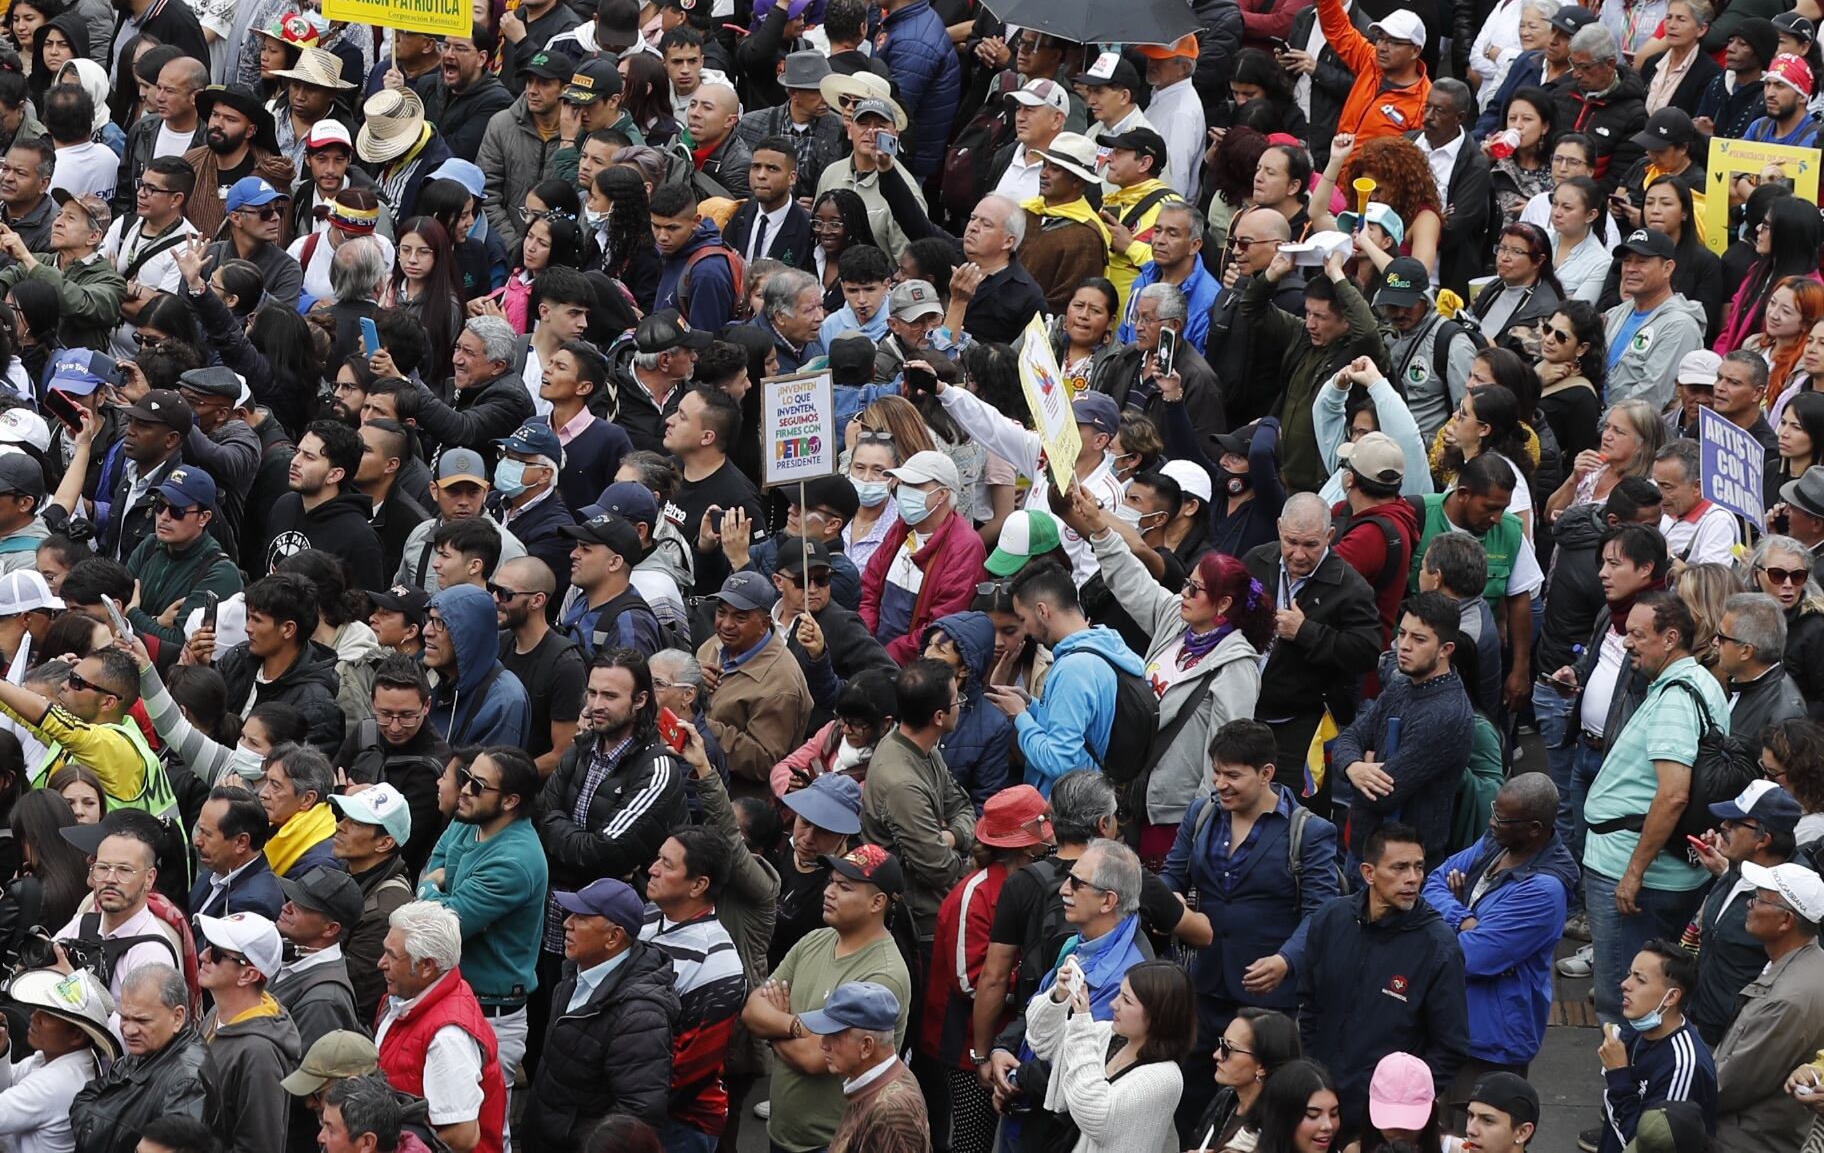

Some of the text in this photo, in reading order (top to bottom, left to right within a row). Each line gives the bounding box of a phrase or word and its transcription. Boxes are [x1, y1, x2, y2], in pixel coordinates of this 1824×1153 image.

[782, 393, 811, 407] LO QUE
[777, 403, 817, 417] INVENTEN,
[779, 413, 819, 427] SEGUIMOS
[775, 423, 821, 439] FIRMES CON
[775, 436, 822, 461] PETRO
[776, 456, 821, 470] PRESIDENTE
